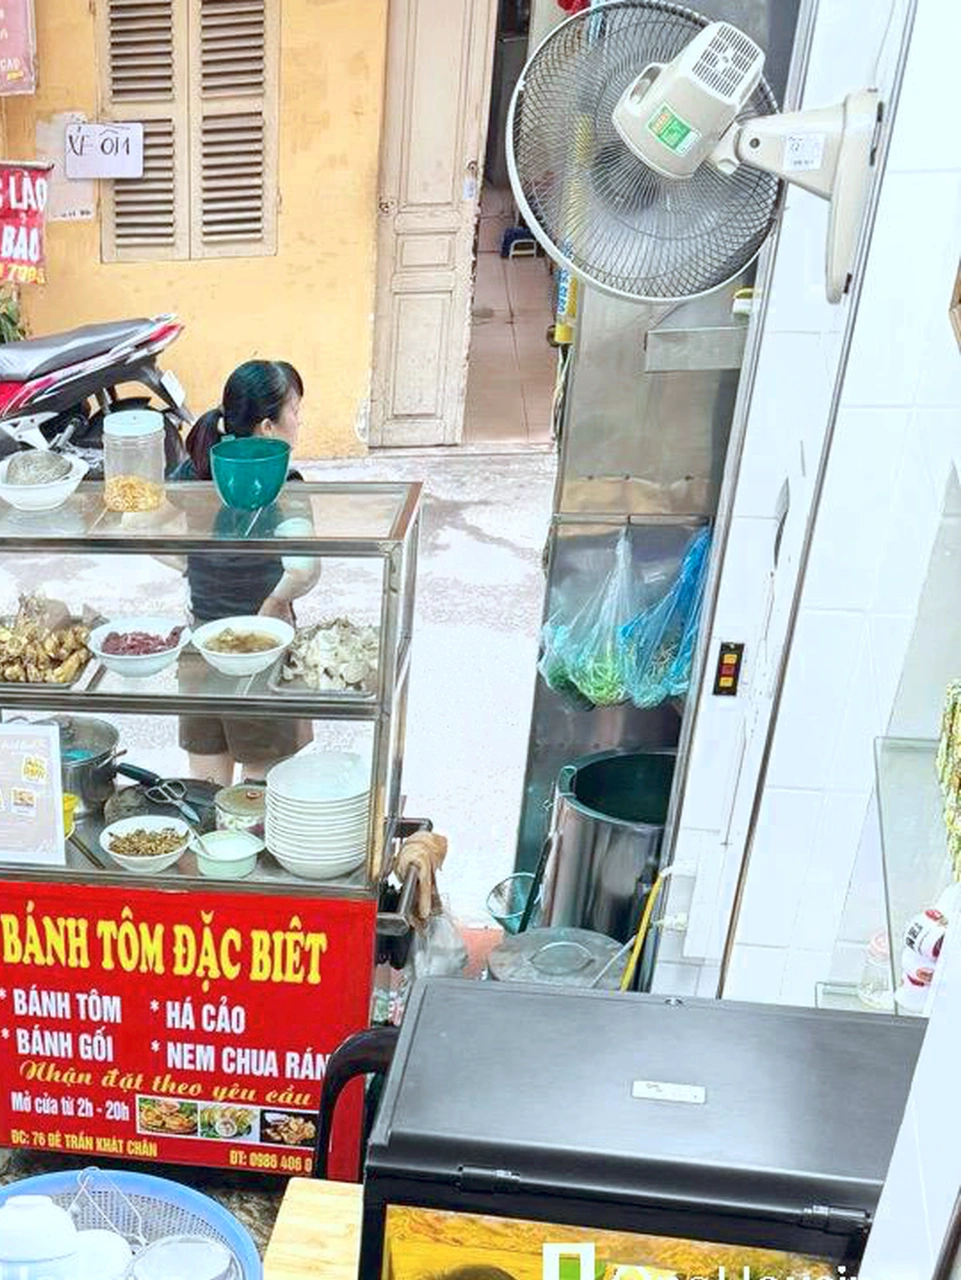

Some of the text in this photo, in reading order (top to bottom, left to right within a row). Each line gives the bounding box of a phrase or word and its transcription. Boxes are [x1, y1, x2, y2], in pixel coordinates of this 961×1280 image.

[9, 169, 48, 212] LÀO
[0, 212, 40, 263] BẢO
[0, 900, 90, 969] BÁNH
[96, 905, 165, 975] TÔM
[172, 910, 242, 993] ĐẶC
[13, 984, 122, 1023] BÁNH TÔM
[166, 995, 246, 1034] HÁ CẢO
[16, 1024, 114, 1062] BÁNH GỐI
[166, 1041, 331, 1081] NEM CHUA RÁN
[19, 1060, 93, 1088] Nhận
[100, 1068, 144, 1093] đặt
[151, 1073, 203, 1097] theo
[211, 1082, 258, 1103] yêu
[11, 1090, 32, 1112] Mở
[34, 1092, 59, 1115] cửa
[77, 1097, 94, 1118] 2h
[105, 1100, 130, 1121] 20h
[32, 1131, 46, 1146] 76
